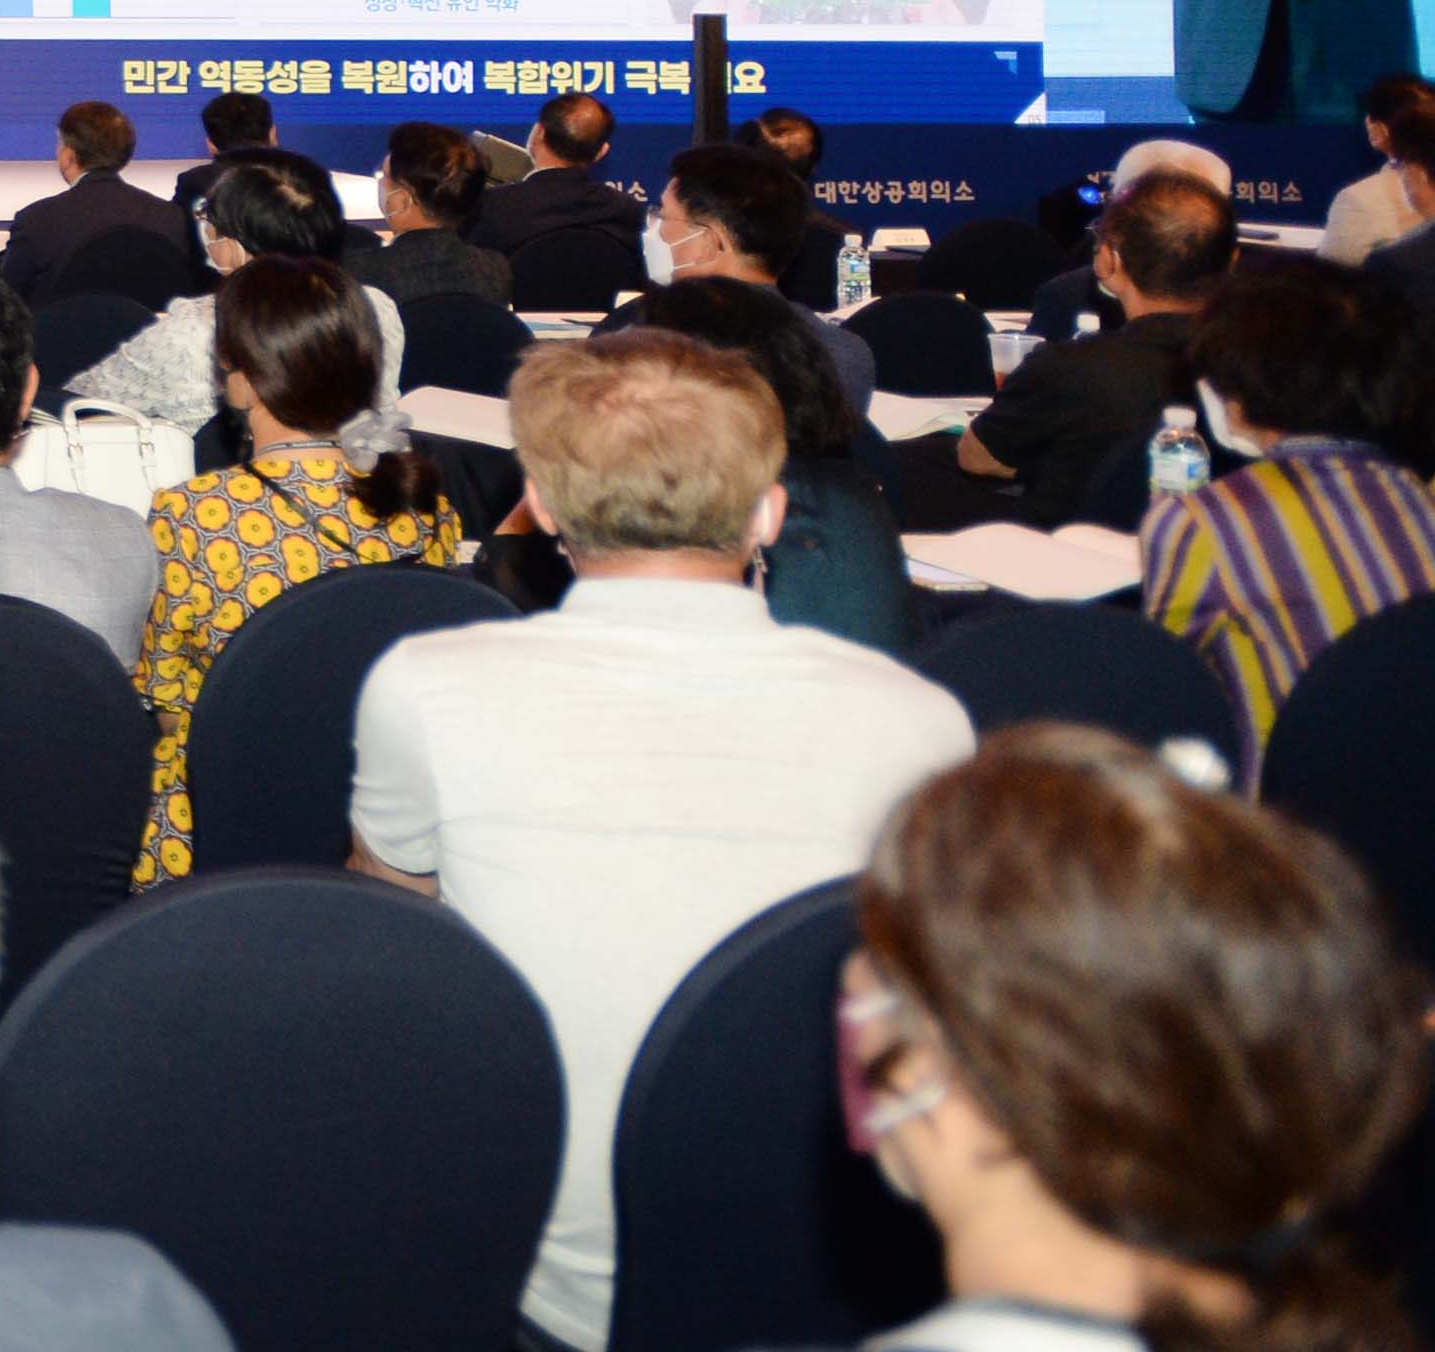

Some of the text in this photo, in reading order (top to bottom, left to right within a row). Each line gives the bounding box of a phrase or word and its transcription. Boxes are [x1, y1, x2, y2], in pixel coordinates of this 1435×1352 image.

[122, 59, 191, 95] 민간
[198, 59, 332, 95] 역동성을
[341, 59, 474, 95] 복원하여
[483, 60, 615, 95] 복합위기
[624, 60, 692, 95] 극복
[814, 179, 976, 205] 대한상공회의소
